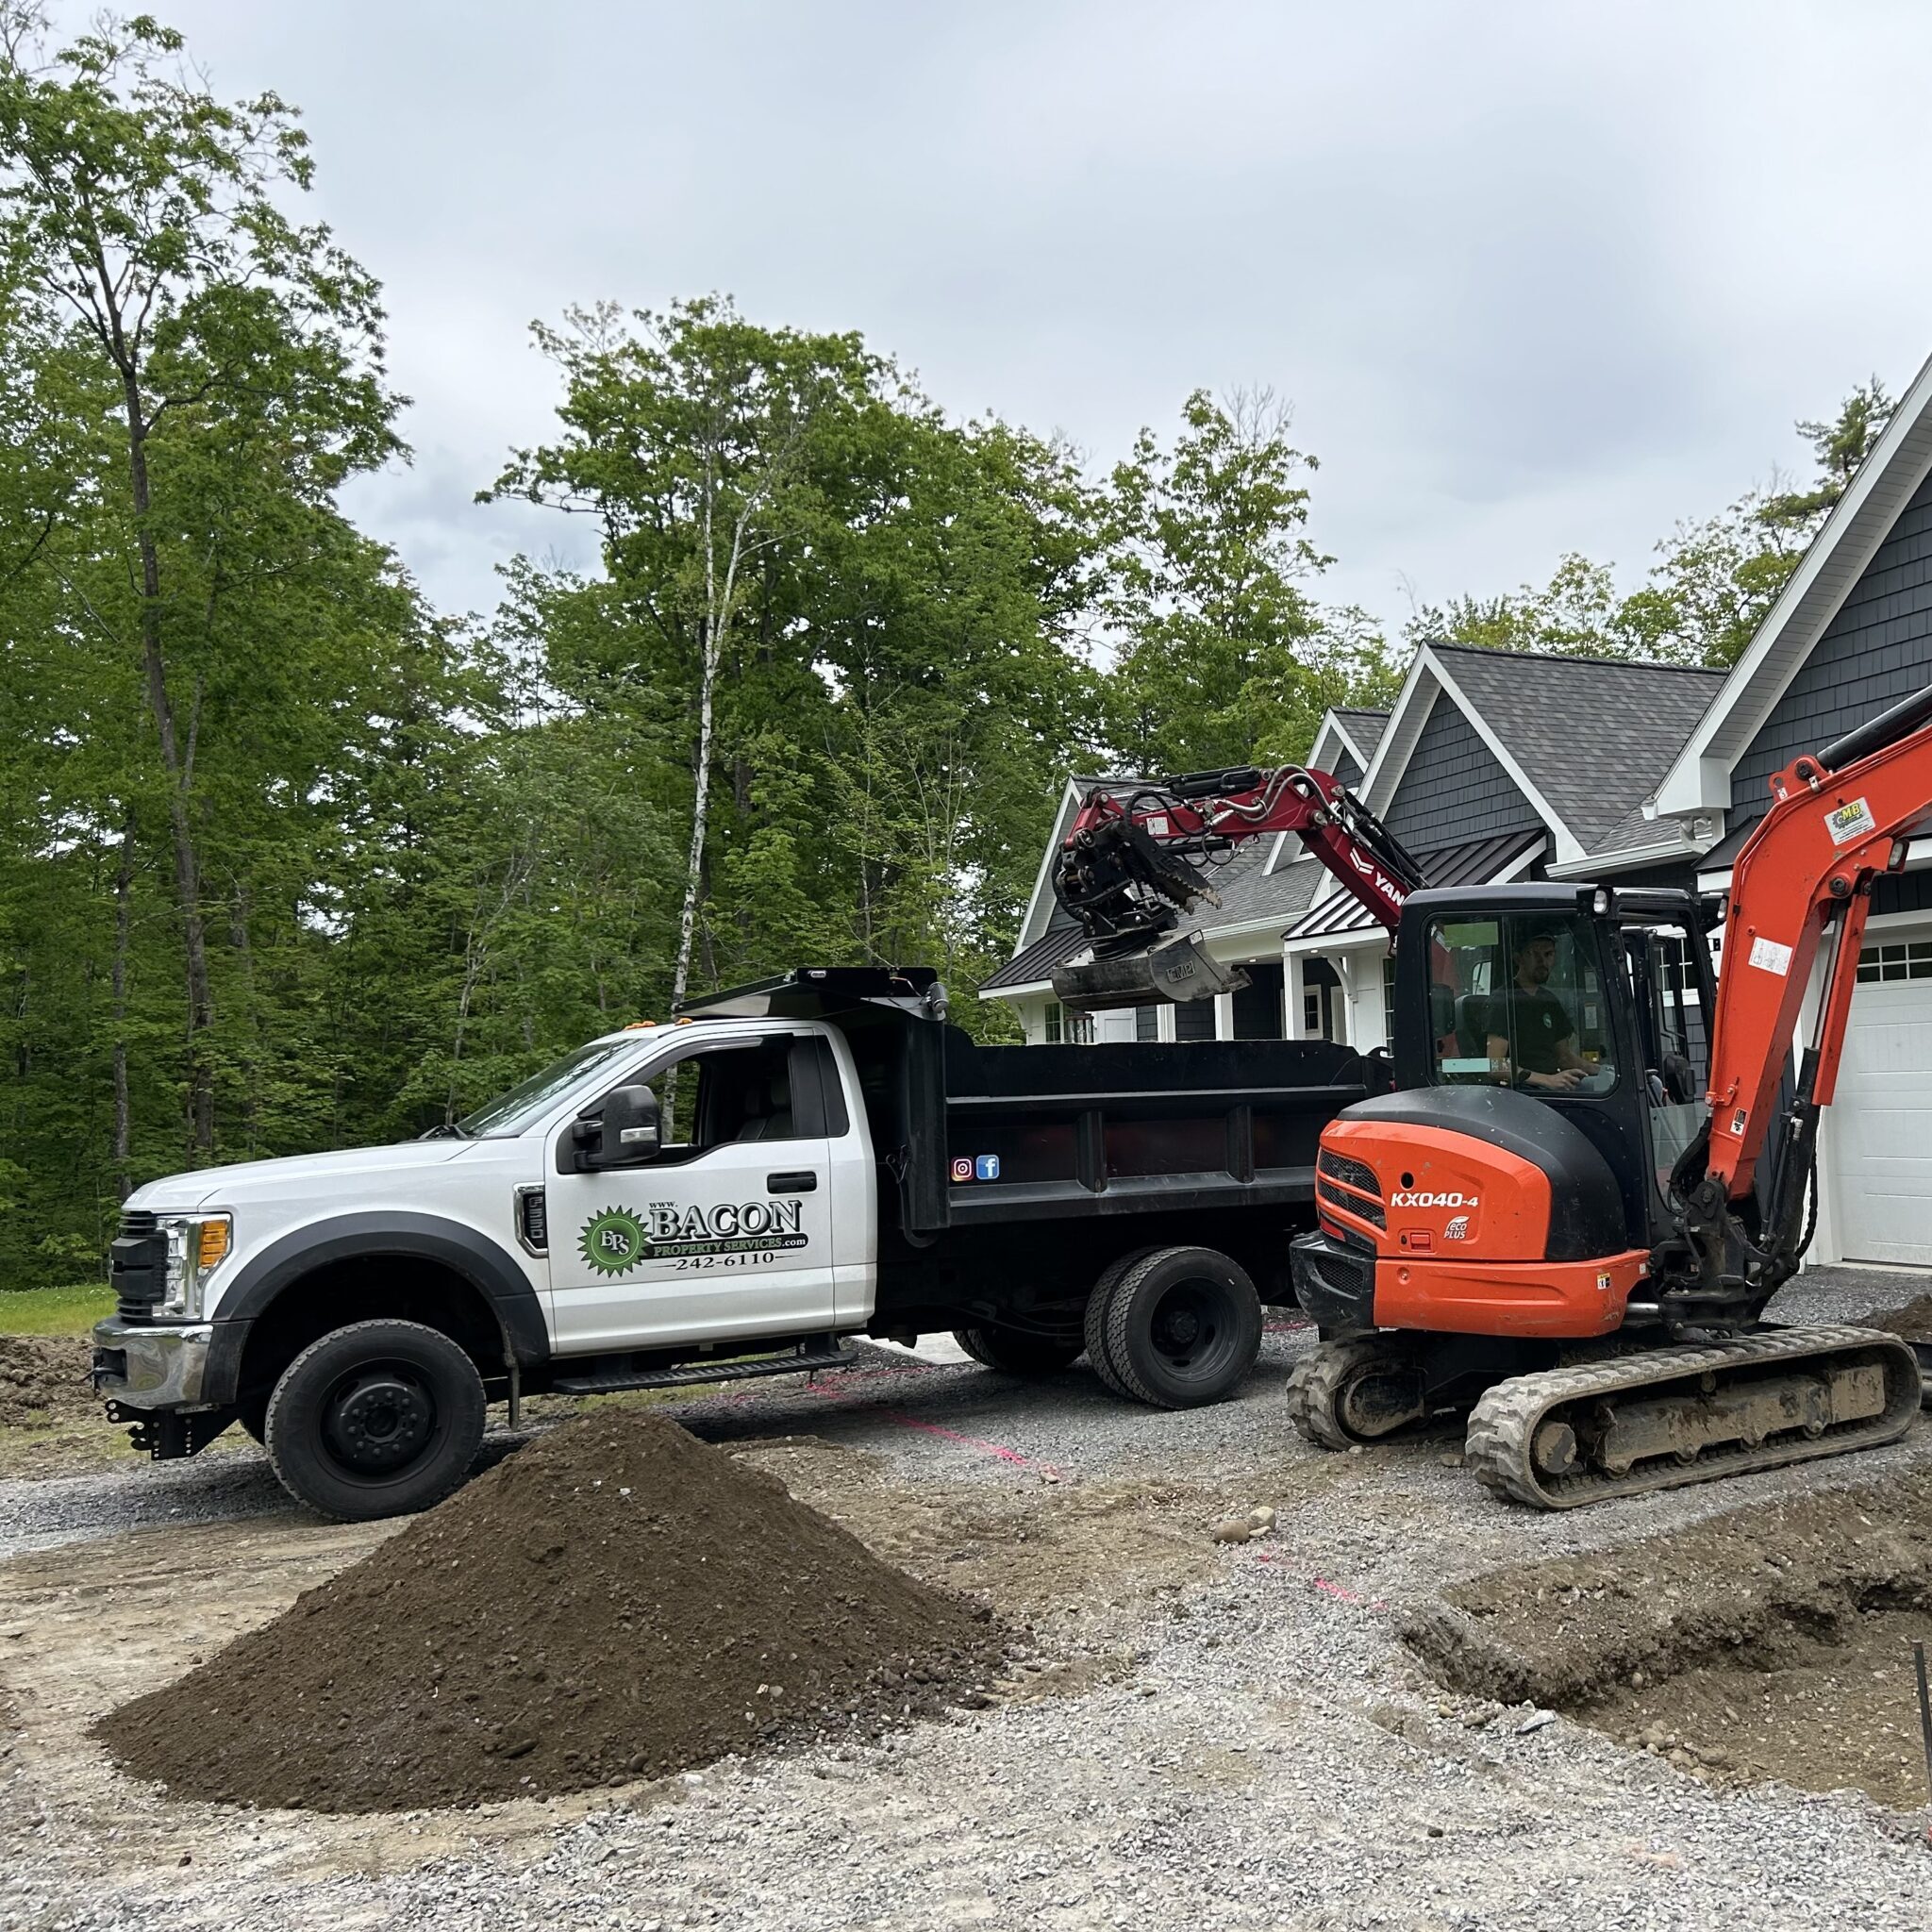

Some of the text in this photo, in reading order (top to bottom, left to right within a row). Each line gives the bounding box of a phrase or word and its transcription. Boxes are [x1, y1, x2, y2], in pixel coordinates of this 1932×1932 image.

[1391, 1192, 1478, 1207] KX040-4
[649, 1199, 803, 1242] BACON
[600, 1230, 630, 1256] BPS
[1443, 1230, 1466, 1239] PLUS
[653, 1241, 723, 1257] PROPERTY
[675, 1252, 774, 1271] 242-6110
